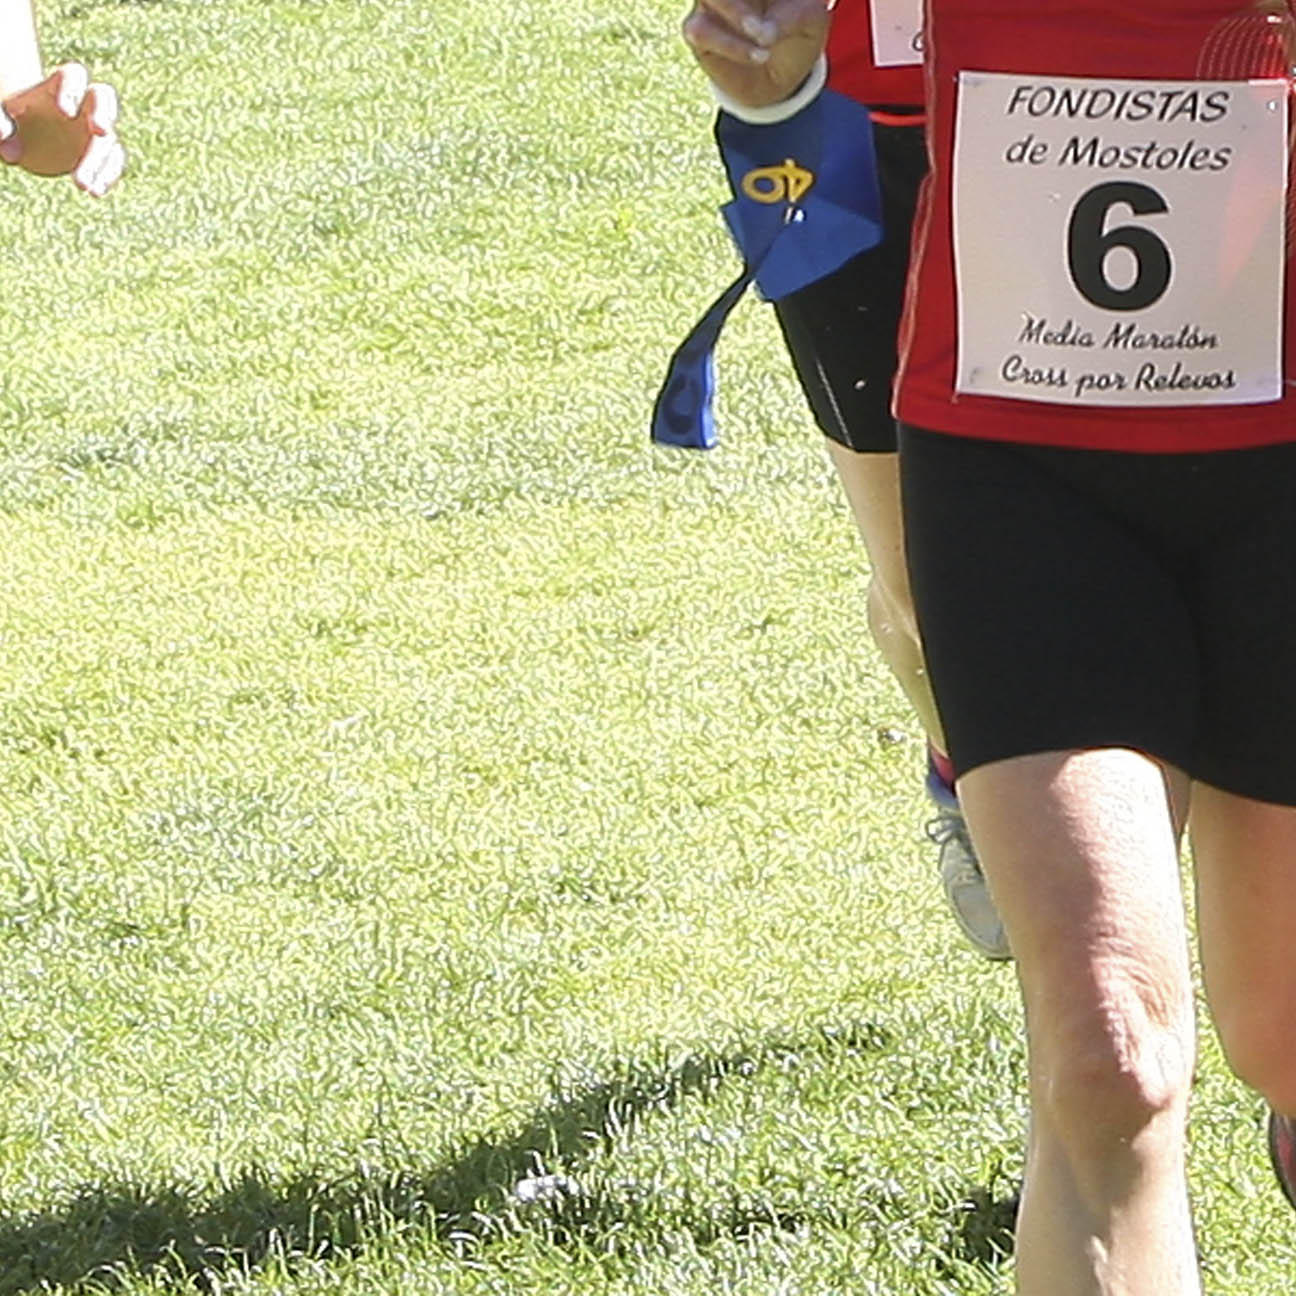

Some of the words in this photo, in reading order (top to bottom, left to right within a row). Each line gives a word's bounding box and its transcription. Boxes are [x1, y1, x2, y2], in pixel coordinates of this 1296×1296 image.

[1007, 85, 1230, 122] FONDISTAS
[1005, 134, 1048, 165] de
[1058, 136, 1232, 171] Mostoles
[1067, 179, 1172, 312] 6
[1018, 317, 1095, 347] Media
[1104, 322, 1218, 350] Maratón
[1001, 355, 1068, 386] Cross
[1075, 369, 1128, 397] por
[1134, 362, 1237, 393] Relevos
